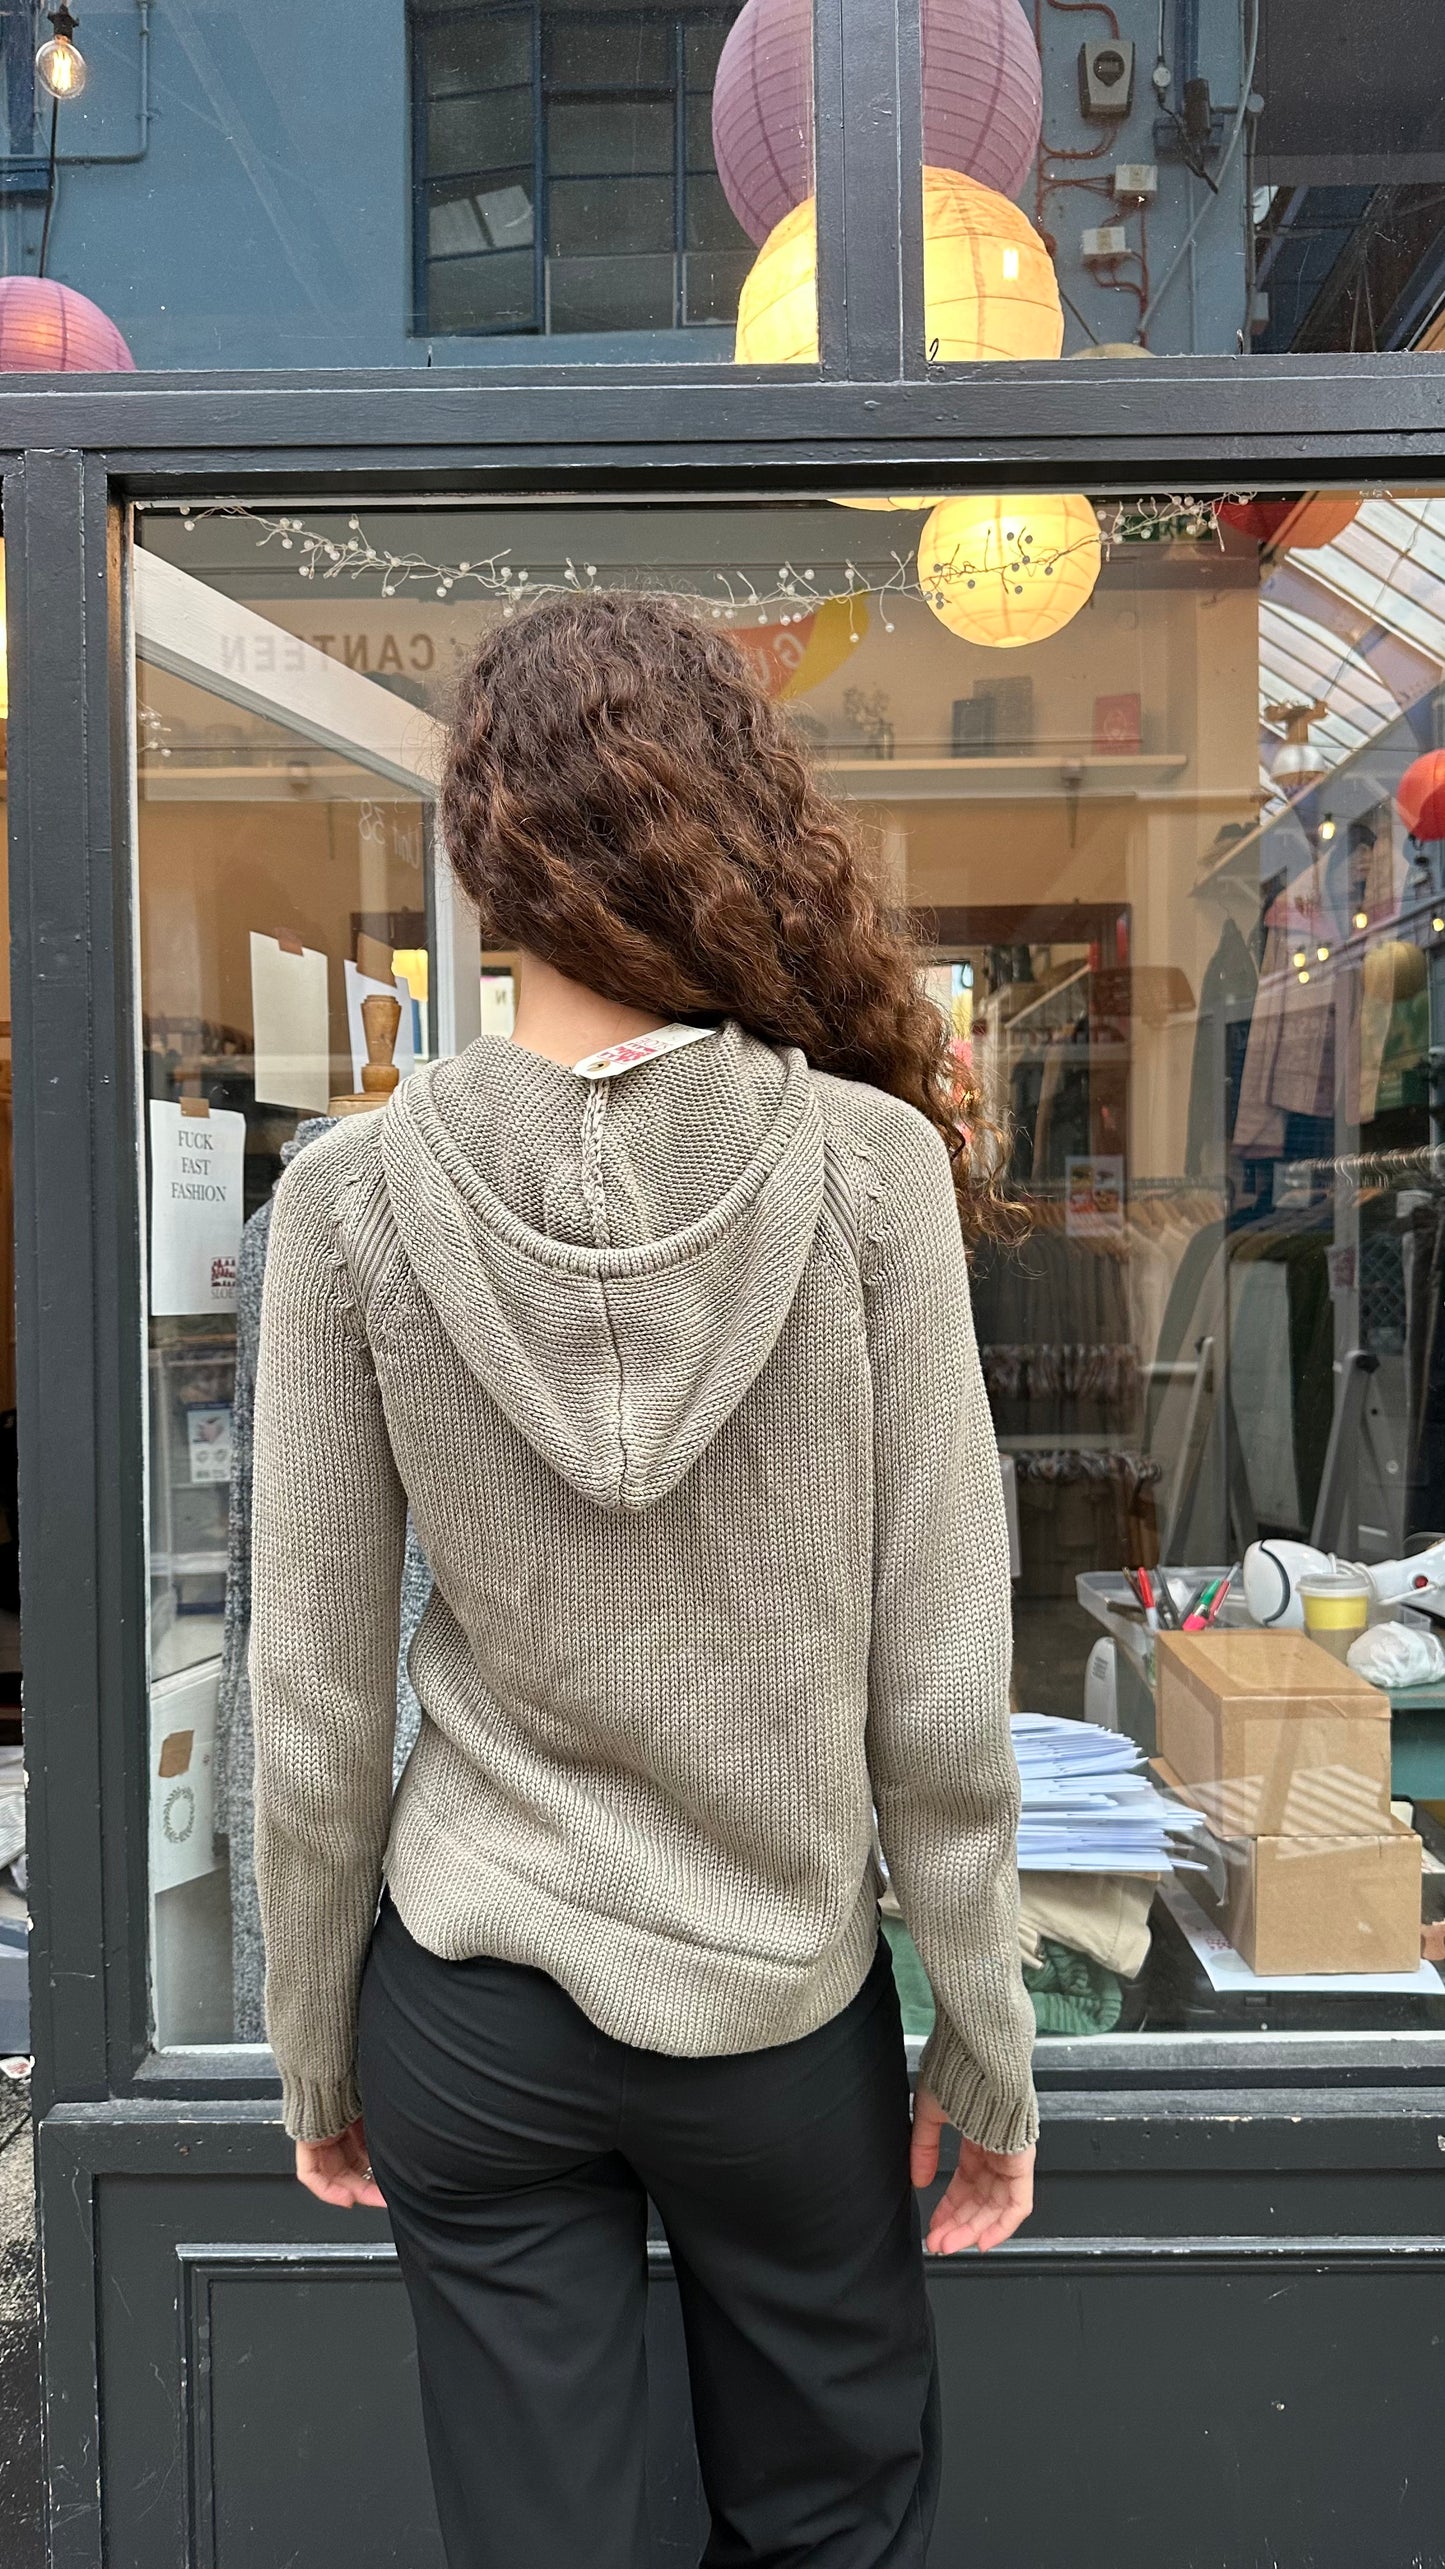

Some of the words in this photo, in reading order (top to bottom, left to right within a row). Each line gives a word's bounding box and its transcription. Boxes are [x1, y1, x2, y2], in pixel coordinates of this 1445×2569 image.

[179, 1130, 213, 1151] FUCK
[182, 1157, 212, 1176] FAST
[172, 1182, 227, 1202] FASHION
